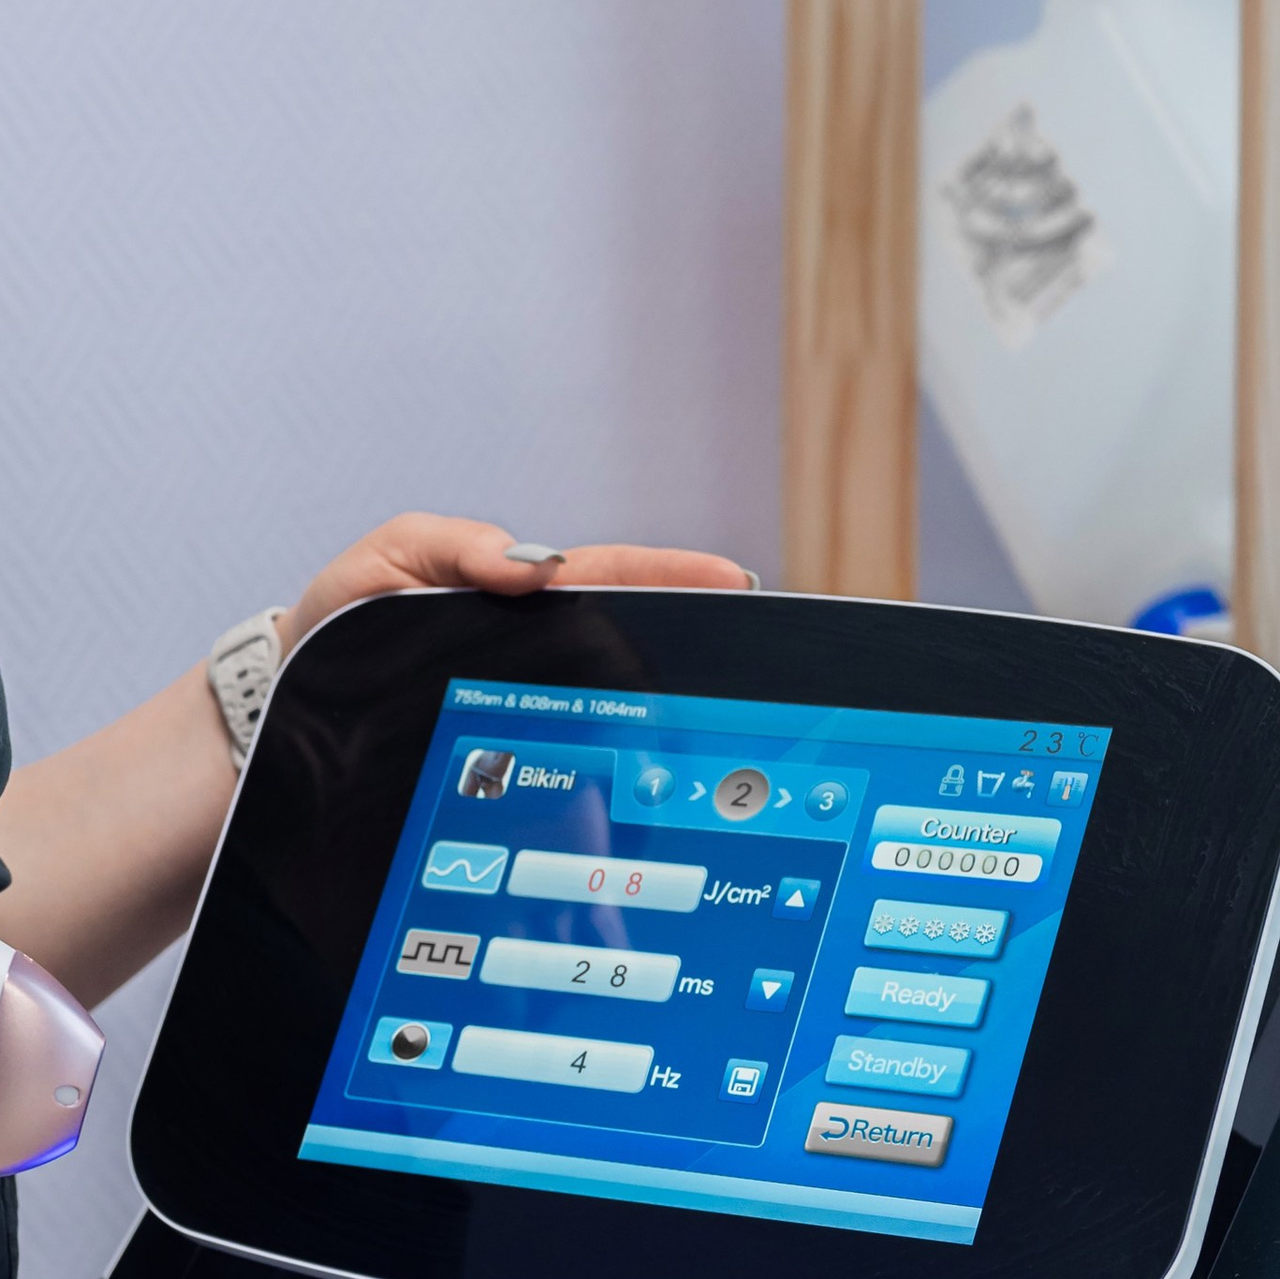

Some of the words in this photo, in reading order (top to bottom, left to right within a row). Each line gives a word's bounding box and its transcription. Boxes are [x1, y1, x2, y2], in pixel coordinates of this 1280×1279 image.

[454, 688, 502, 706] 755nm
[504, 693, 516, 708] &
[519, 694, 570, 712] 808nm
[572, 699, 583, 714] &
[589, 699, 647, 718] 1064nm
[516, 765, 577, 791] Bikini
[650, 777, 661, 796] 1
[730, 782, 753, 807] 2
[818, 791, 835, 811] 3
[920, 817, 1018, 845] Counter
[893, 847, 1020, 877] 000000
[678, 976, 714, 996] ms
[880, 980, 956, 1013] Ready
[570, 1050, 588, 1074] 4
[650, 1065, 682, 1089] Hz
[847, 1049, 948, 1084] Standby
[849, 1118, 934, 1150] Return
